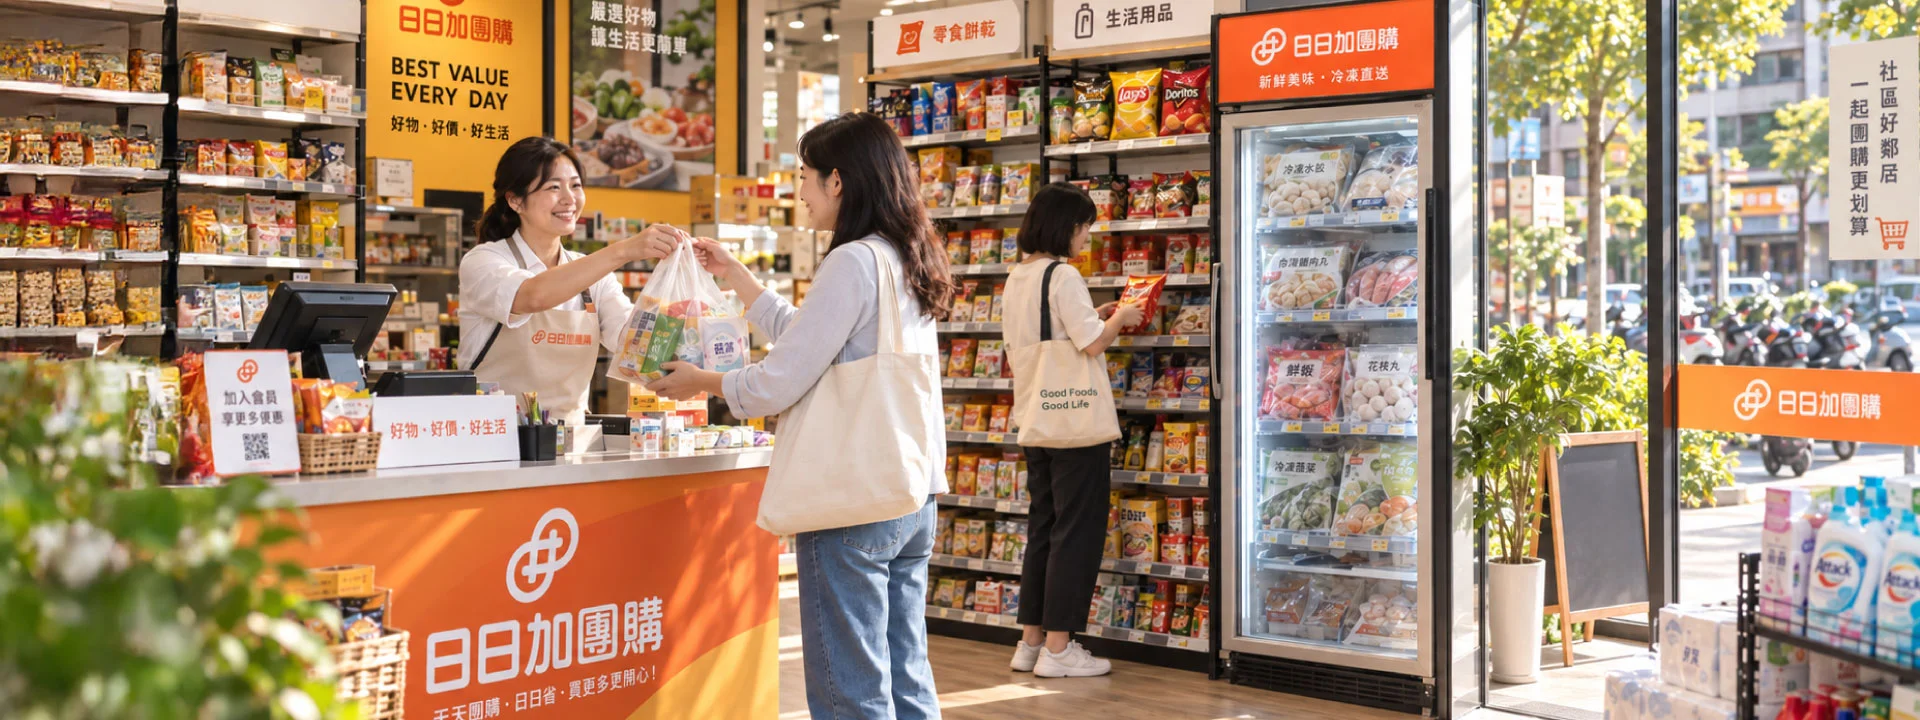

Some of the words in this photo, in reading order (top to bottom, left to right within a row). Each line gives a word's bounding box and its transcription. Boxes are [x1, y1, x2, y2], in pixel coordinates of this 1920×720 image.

[399, 5, 513, 45] 日日加團購
[590, 0, 657, 28] 嚴選好物
[1105, 3, 1173, 29] 生活用品
[590, 25, 687, 57] 讓生活更簡單
[933, 19, 996, 44] 零食餅乾
[1294, 26, 1399, 58] 日日加團購
[391, 56, 440, 80] BEST
[448, 63, 509, 87] VALUE
[391, 81, 458, 106] EVERY
[469, 89, 508, 111] DAY
[1165, 87, 1199, 100] Doritos
[1879, 59, 1899, 184] 社區好鄰居
[1849, 81, 1869, 236] 一起團購更划算
[224, 389, 278, 406] 加入會員
[1040, 388, 1067, 399] Good
[1069, 387, 1098, 398] Foods
[1041, 400, 1069, 411] Good
[1071, 399, 1090, 409] Life
[1778, 390, 1881, 420] 日日加團購
[221, 410, 284, 427] 享更多優惠
[1815, 556, 1852, 577] Attack
[426, 595, 664, 695] 日日加團購
